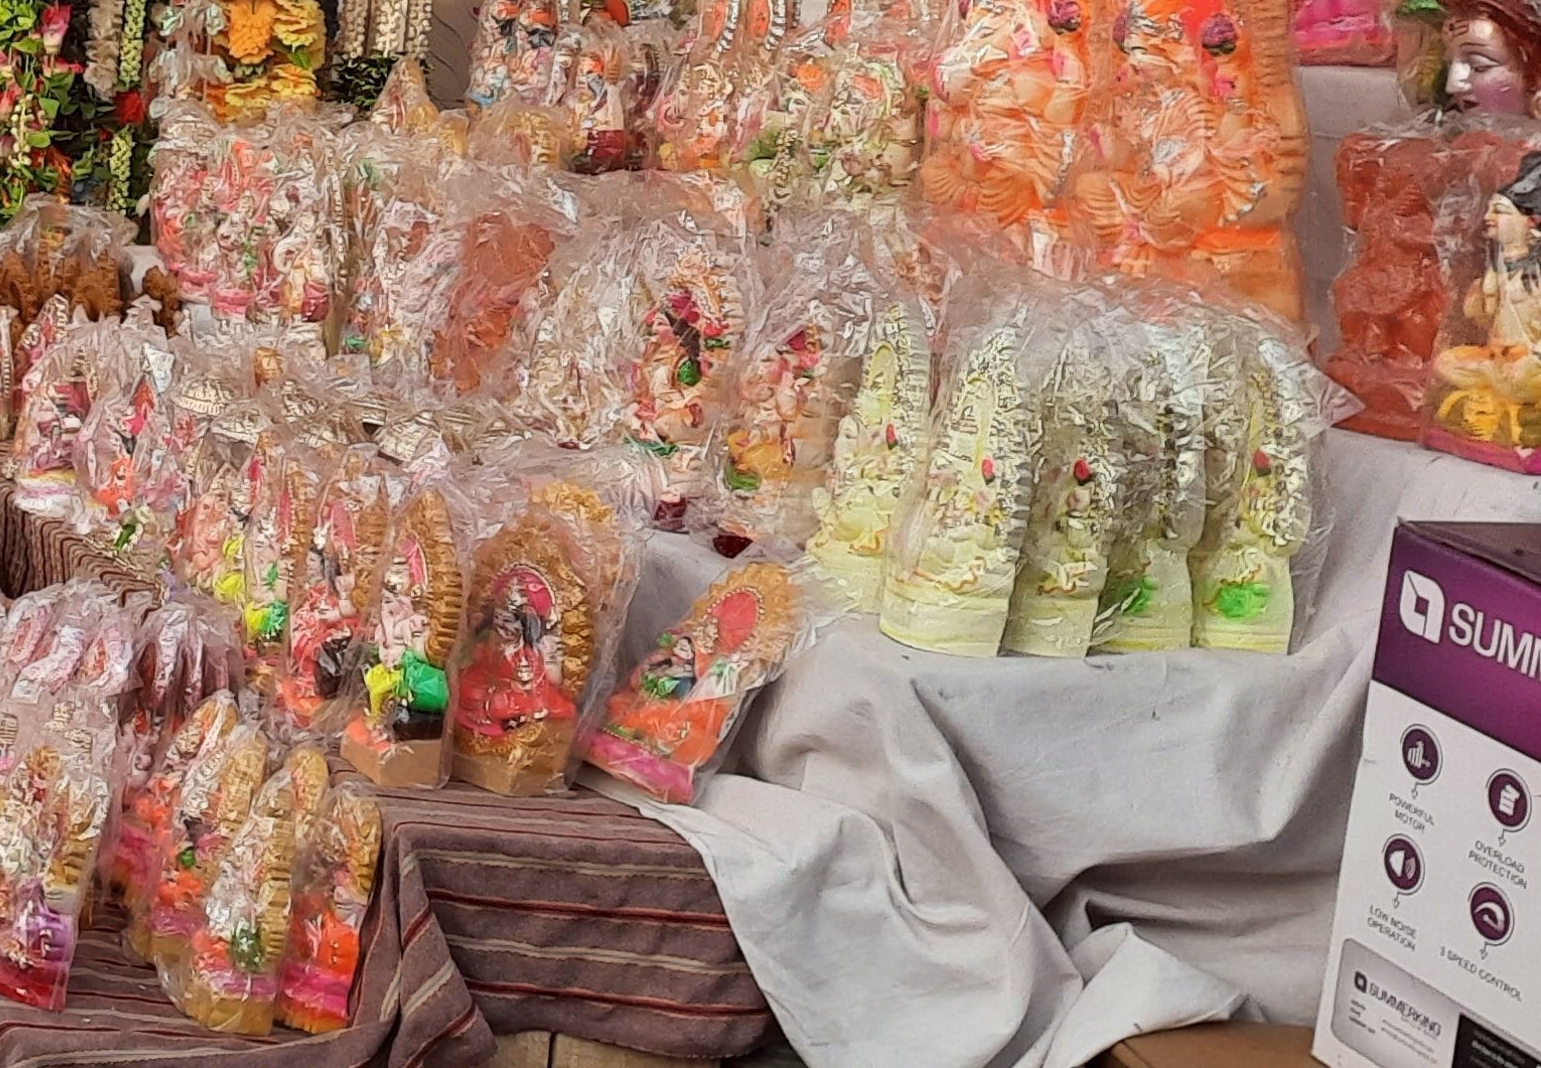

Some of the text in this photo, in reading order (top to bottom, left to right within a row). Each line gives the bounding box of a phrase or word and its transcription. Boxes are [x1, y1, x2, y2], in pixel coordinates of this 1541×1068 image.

[1389, 792, 1436, 826] POWERFUL
[1394, 810, 1426, 834] MOTOR
[1468, 850, 1528, 890] PROTECTION
[1475, 839, 1526, 874] OVERLOAD
[1367, 917, 1416, 953] OPERATION
[1369, 904, 1418, 940] LOW NOISE
[1447, 951, 1478, 975] SPEED
[1478, 965, 1524, 1003] CONTROL
[1368, 982, 1443, 1037] SUMMERKING
